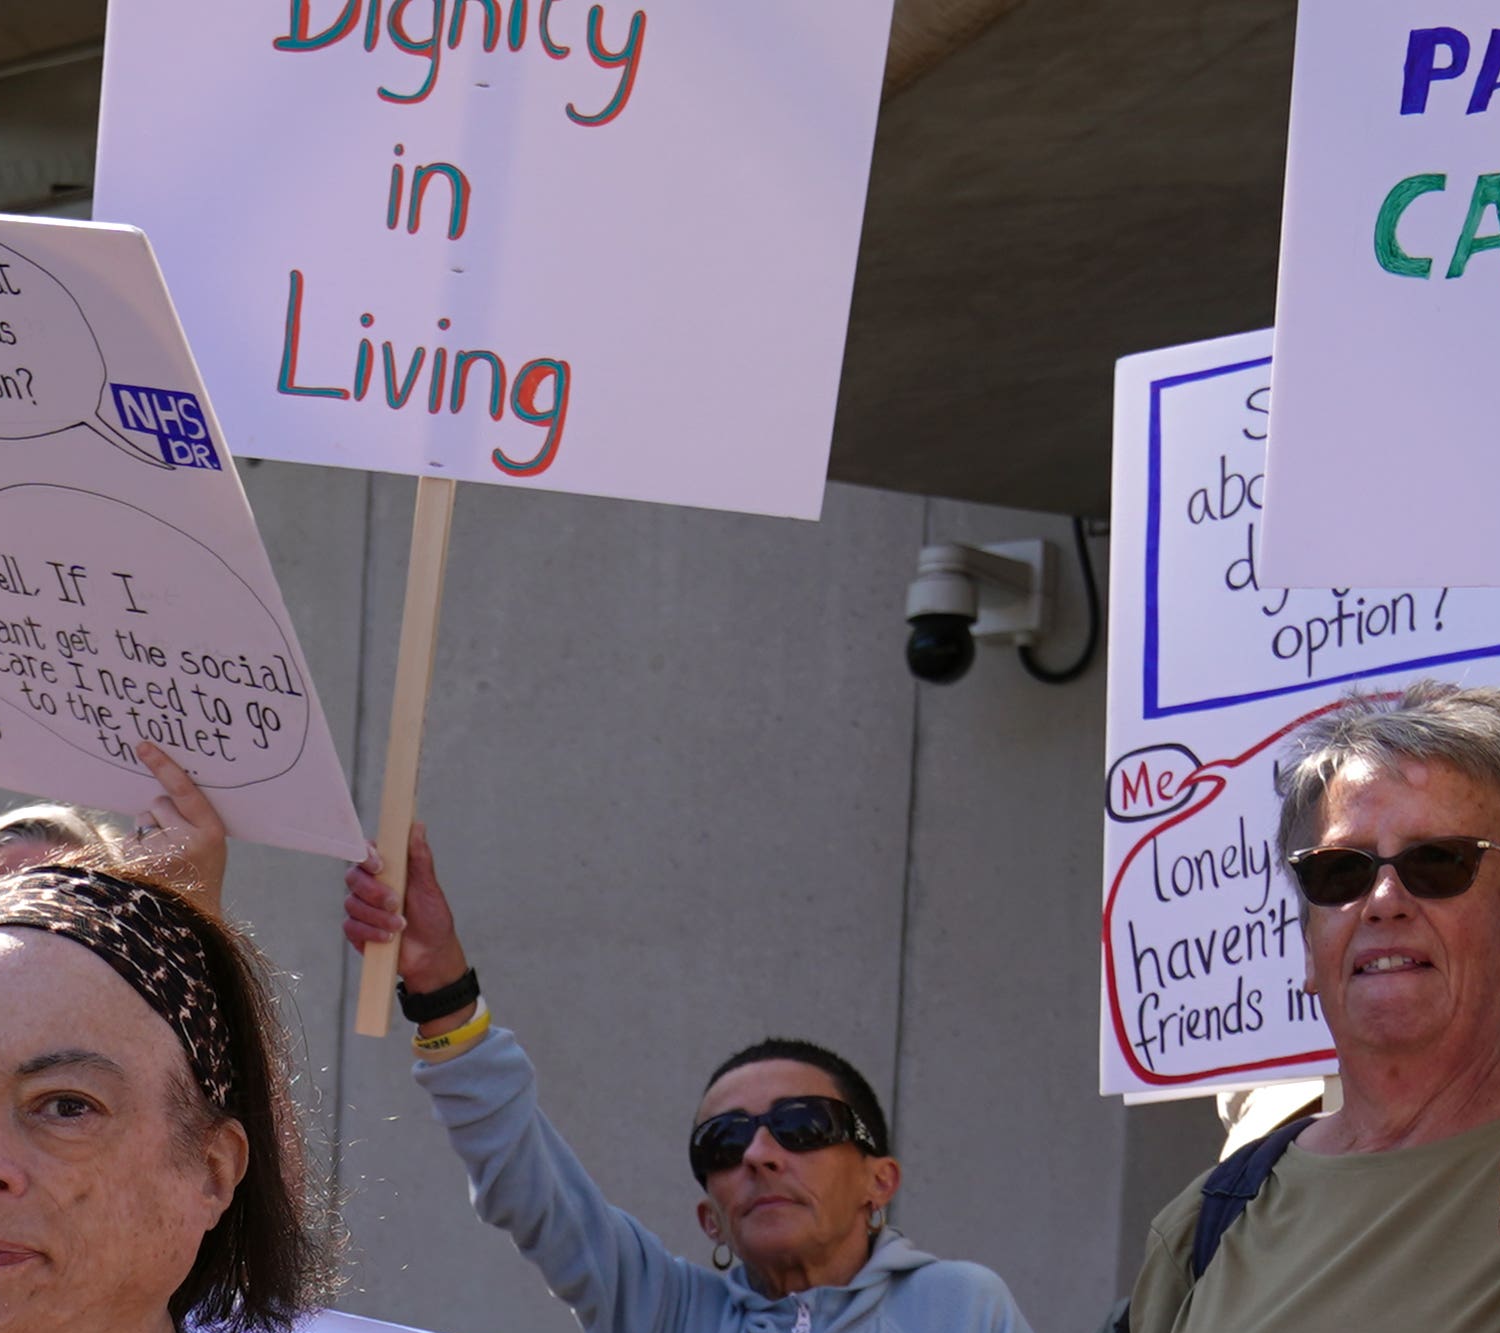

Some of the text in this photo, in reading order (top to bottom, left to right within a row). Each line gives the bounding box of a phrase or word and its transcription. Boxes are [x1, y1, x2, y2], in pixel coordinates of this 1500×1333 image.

[387, 143, 472, 240] in
[120, 387, 203, 440] NHS
[277, 268, 571, 477] Living
[46, 561, 88, 606] If
[111, 571, 149, 614] I
[56, 623, 99, 659] get
[115, 628, 168, 669] the
[180, 646, 304, 697] social
[21, 681, 238, 762] to the toilet
[67, 661, 94, 692] I
[97, 666, 187, 717] need
[192, 684, 233, 728] to
[246, 700, 282, 751] go
[1120, 761, 1174, 811] Me
[1152, 816, 1272, 914] lonely
[1128, 898, 1299, 995] haven't
[1134, 976, 1265, 1072] friends
